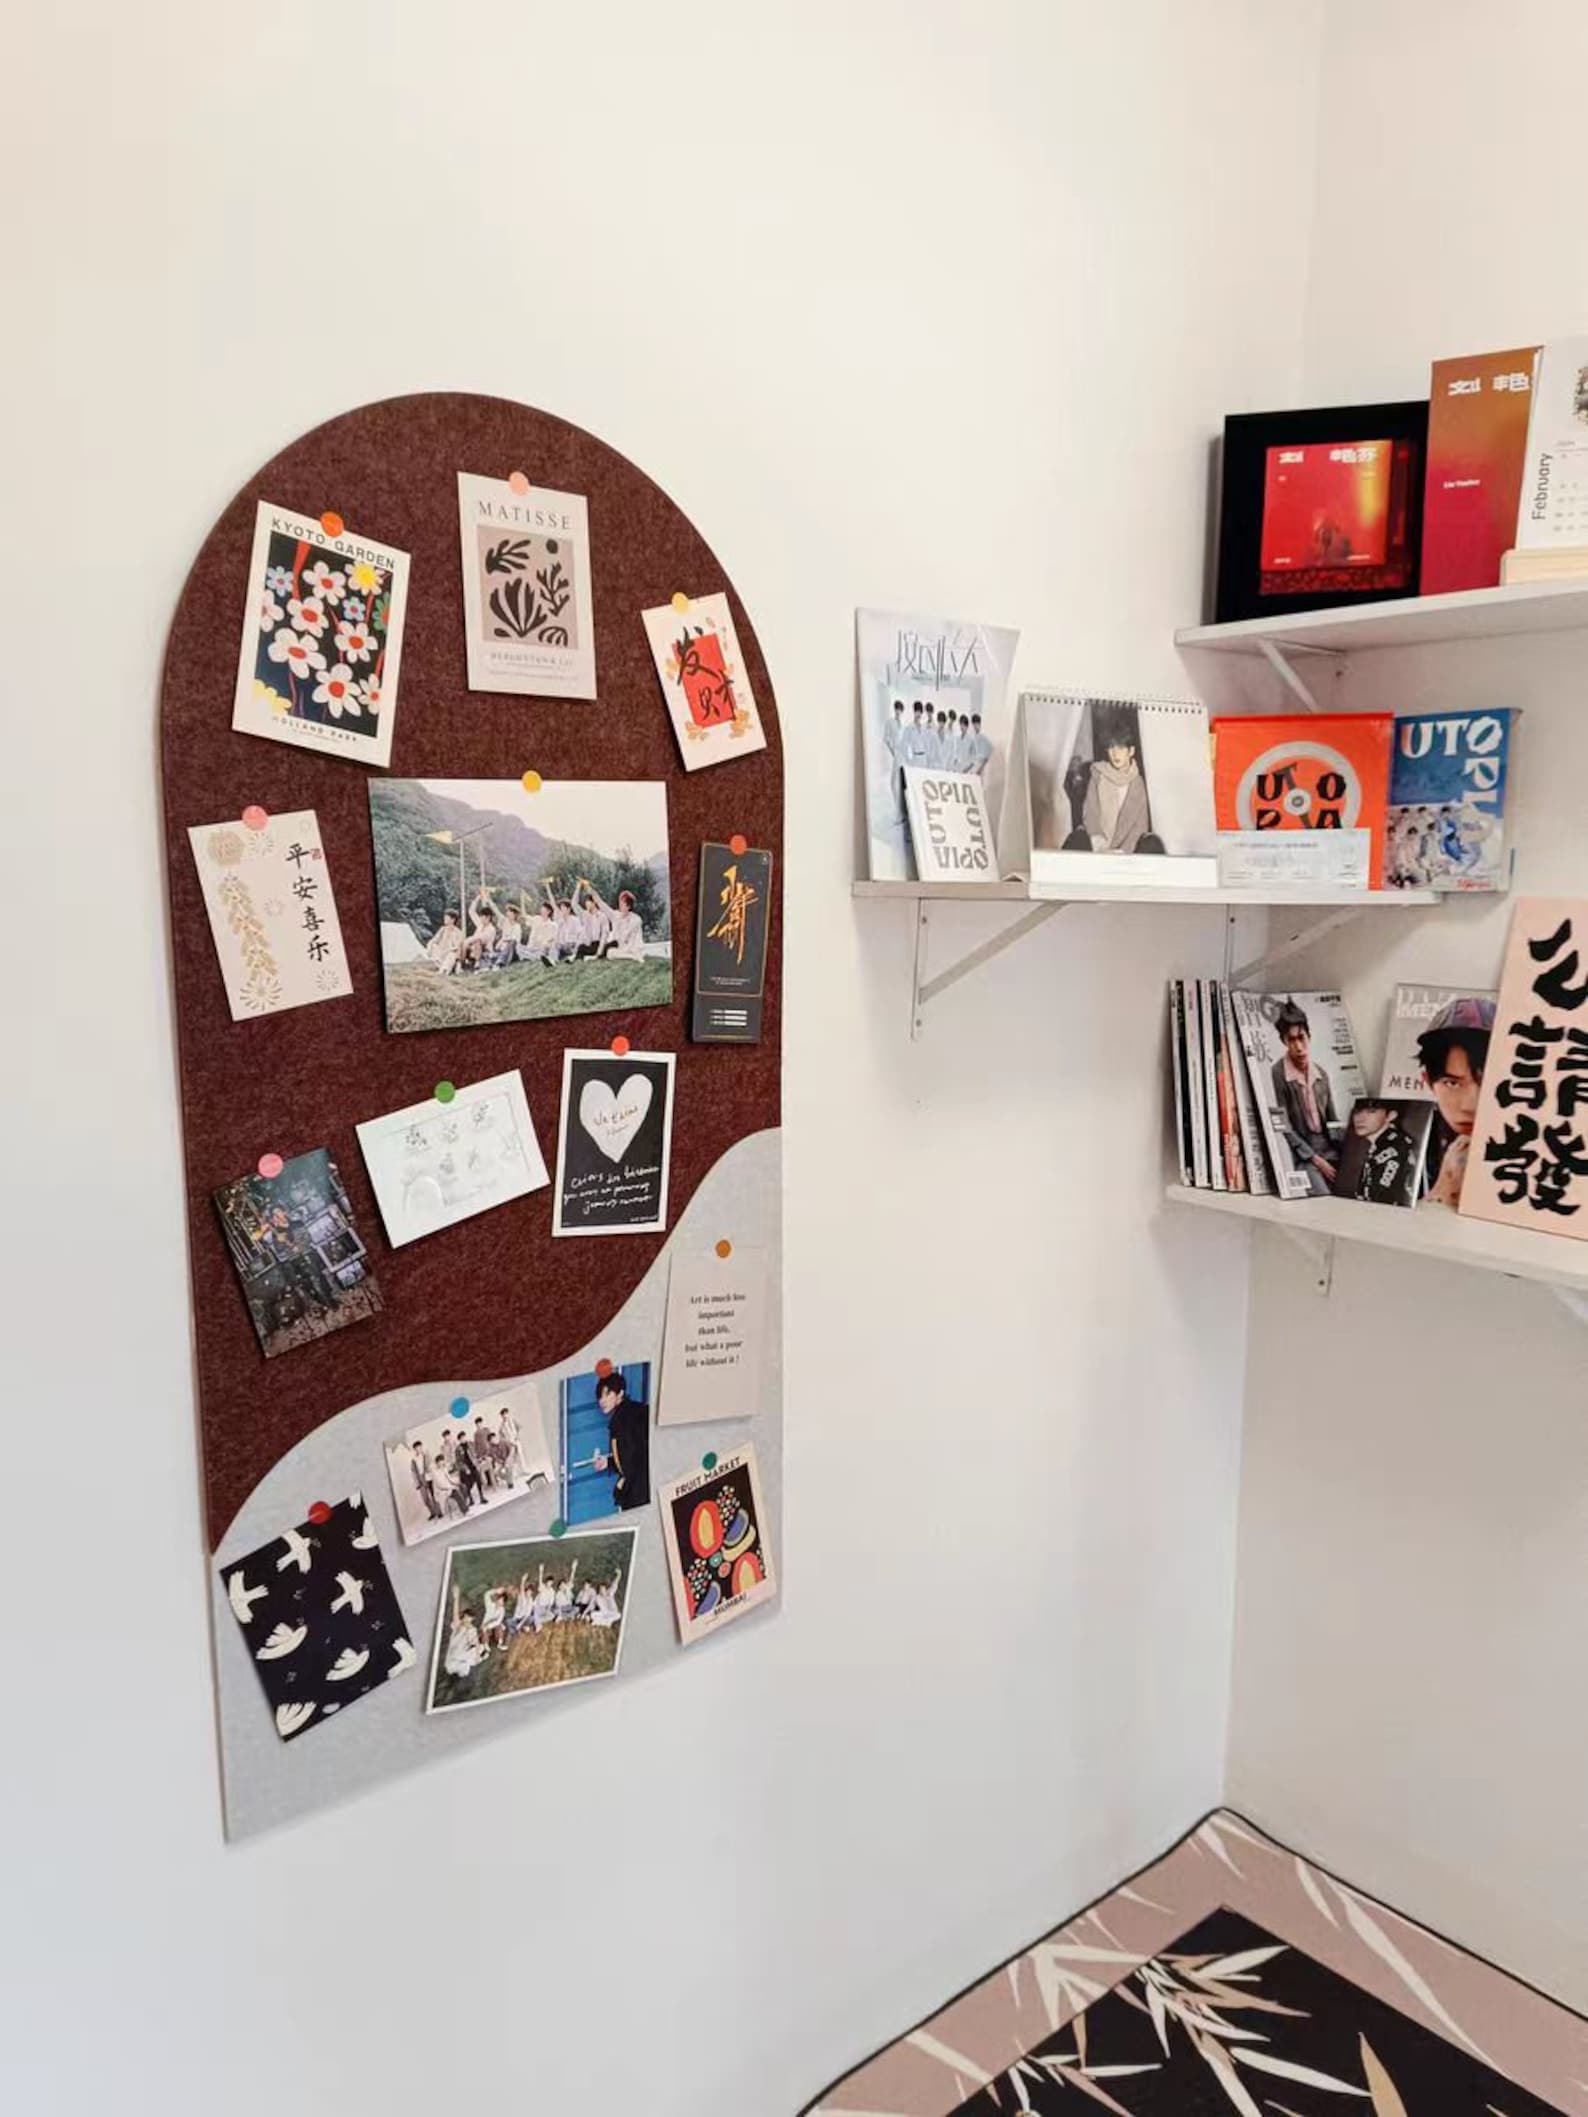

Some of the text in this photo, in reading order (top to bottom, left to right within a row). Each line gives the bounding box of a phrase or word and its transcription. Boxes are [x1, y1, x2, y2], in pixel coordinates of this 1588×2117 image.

[1532, 452, 1553, 521] February
[479, 500, 571, 530] MATISSE
[272, 516, 395, 569] KYOTO GARDEN
[285, 842, 331, 963] 平安喜乐
[690, 1295, 702, 1304] Art
[703, 1294, 710, 1302] is
[711, 1293, 731, 1302] much
[697, 1309, 735, 1320] important
[698, 1326, 716, 1335] than
[685, 1343, 698, 1353] but
[700, 1342, 717, 1350] what
[725, 1340, 743, 1350] poor
[700, 1355, 727, 1366] without
[675, 1456, 741, 1498] FRUIT MARKET
